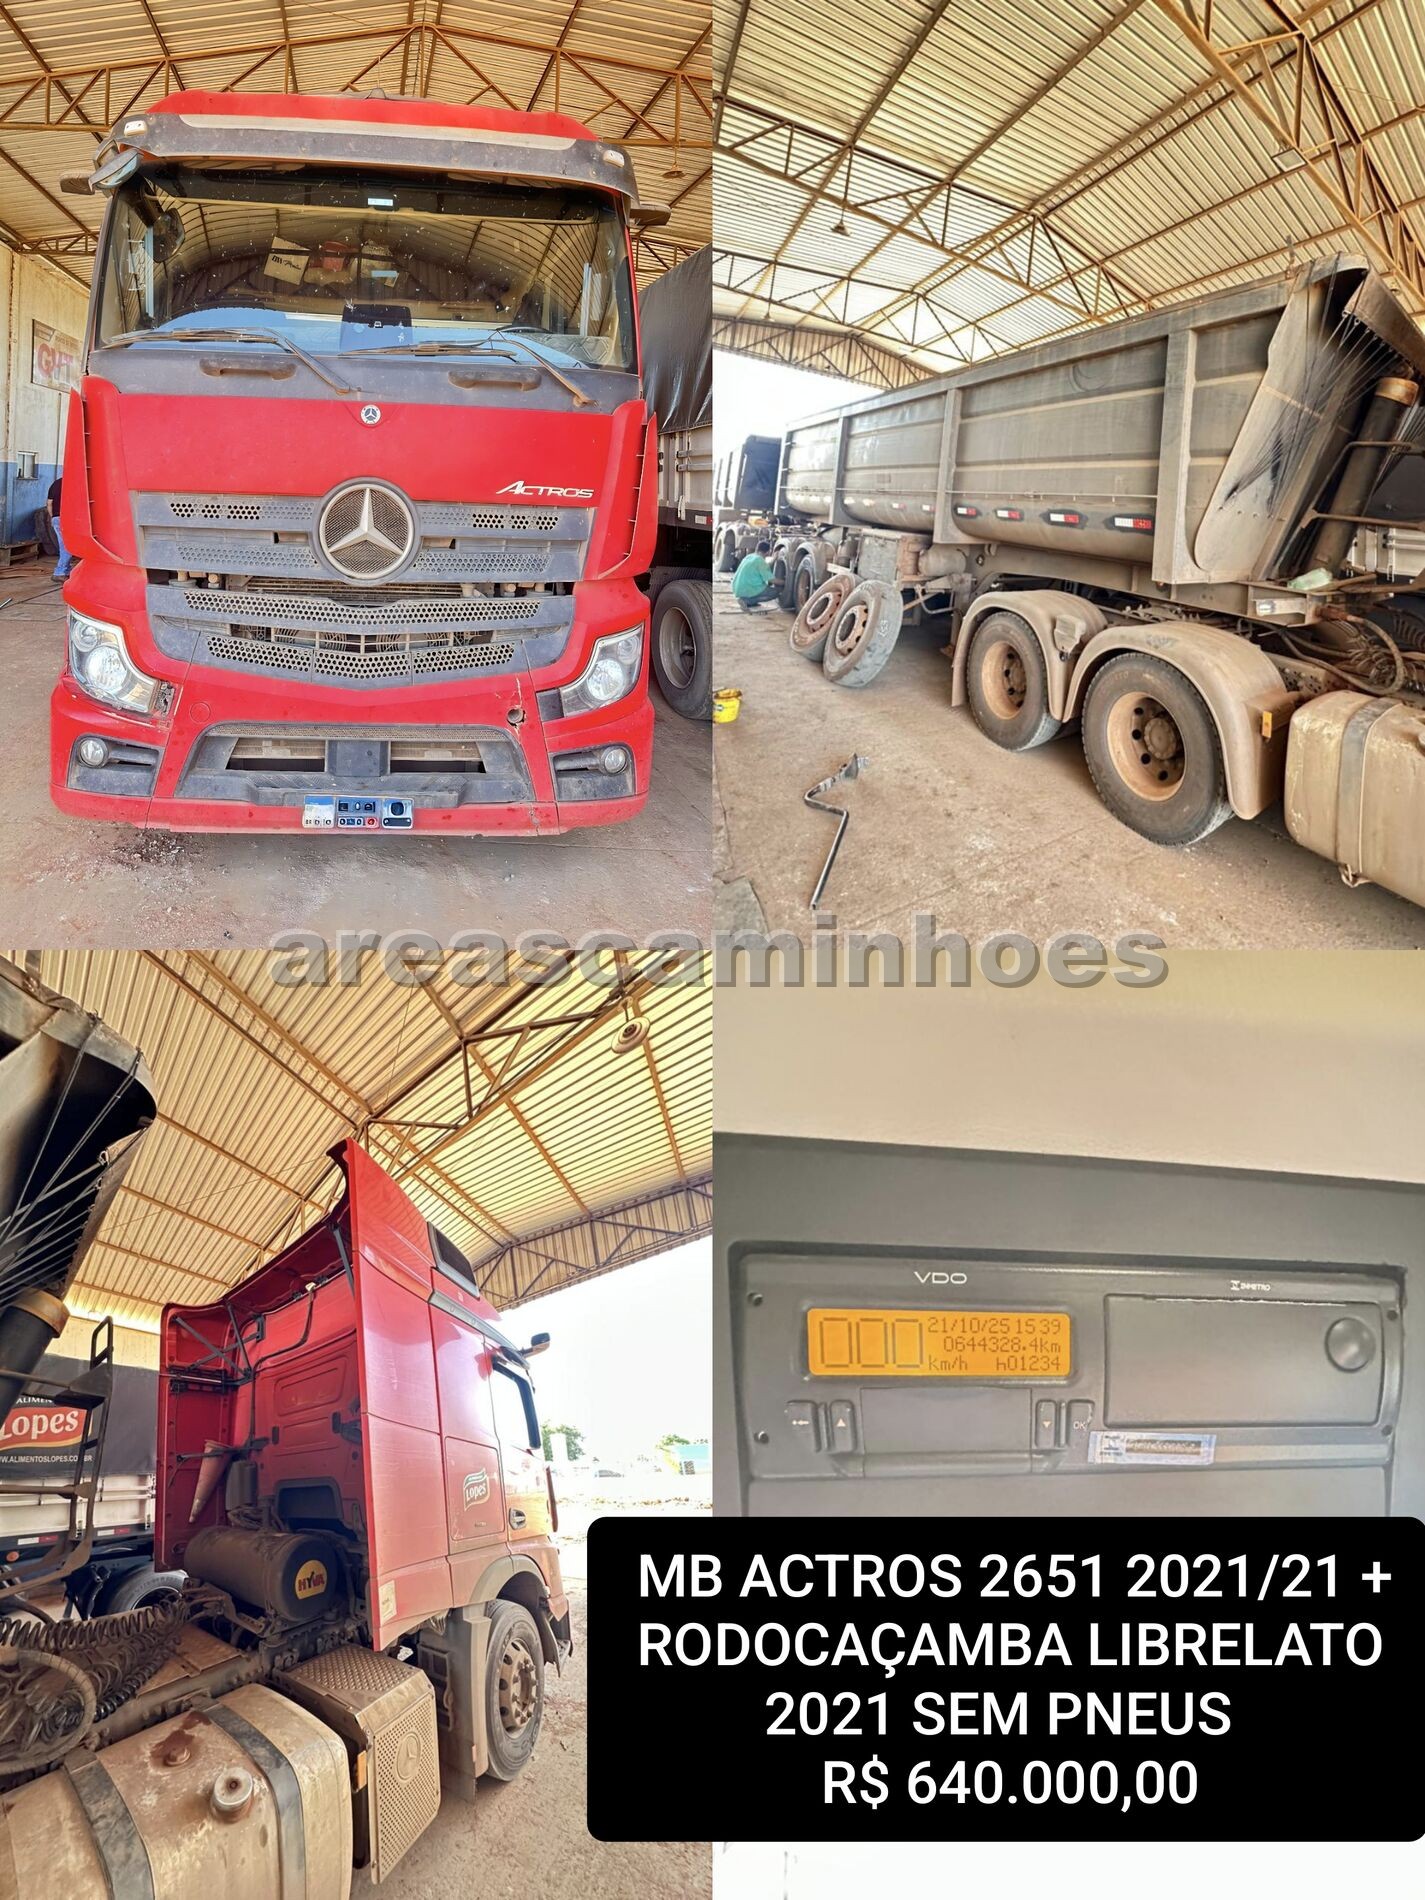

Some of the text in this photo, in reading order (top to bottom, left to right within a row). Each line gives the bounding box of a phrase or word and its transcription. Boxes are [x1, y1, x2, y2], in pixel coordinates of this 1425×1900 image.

[496, 481, 595, 499] ACTROS
[914, 1271, 968, 1284] VDO
[928, 1316, 1010, 1334] 21/10/25
[16, 1396, 53, 1404] ALIMEN
